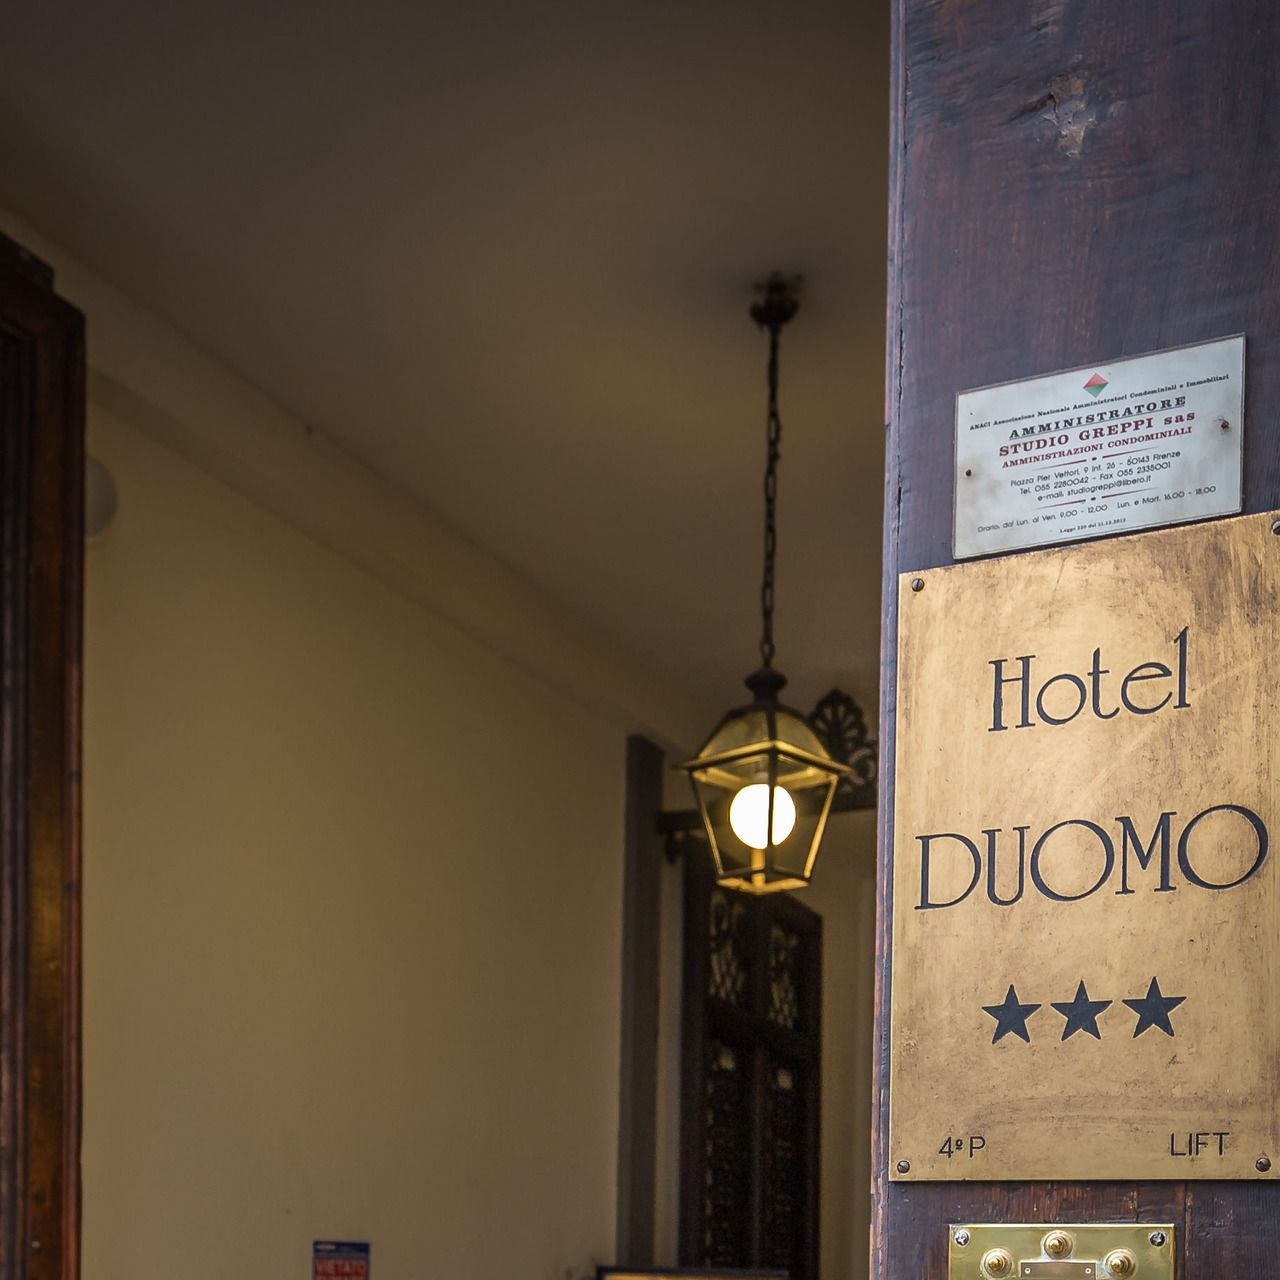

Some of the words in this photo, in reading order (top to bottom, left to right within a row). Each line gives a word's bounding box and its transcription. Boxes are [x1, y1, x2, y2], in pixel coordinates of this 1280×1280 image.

[1037, 406, 1070, 417] Nazionale
[1073, 394, 1128, 410] Amministratori
[1130, 384, 1177, 399] Condominiali
[1186, 374, 1230, 387] Immobiliari
[999, 434, 1069, 457] STUDIO
[1078, 417, 1154, 441] GREPPI
[1163, 412, 1195, 425] sas
[1009, 396, 1186, 439] AMMINISTRATORE
[1002, 443, 1103, 468] AMMINISTRAZIONI
[1107, 426, 1192, 448] CONDOMINIALI
[1153, 451, 1181, 461] Firenze
[987, 626, 1191, 732] Hotel
[913, 804, 1270, 911] DUOMO
[1169, 1132, 1231, 1157] LIFT
